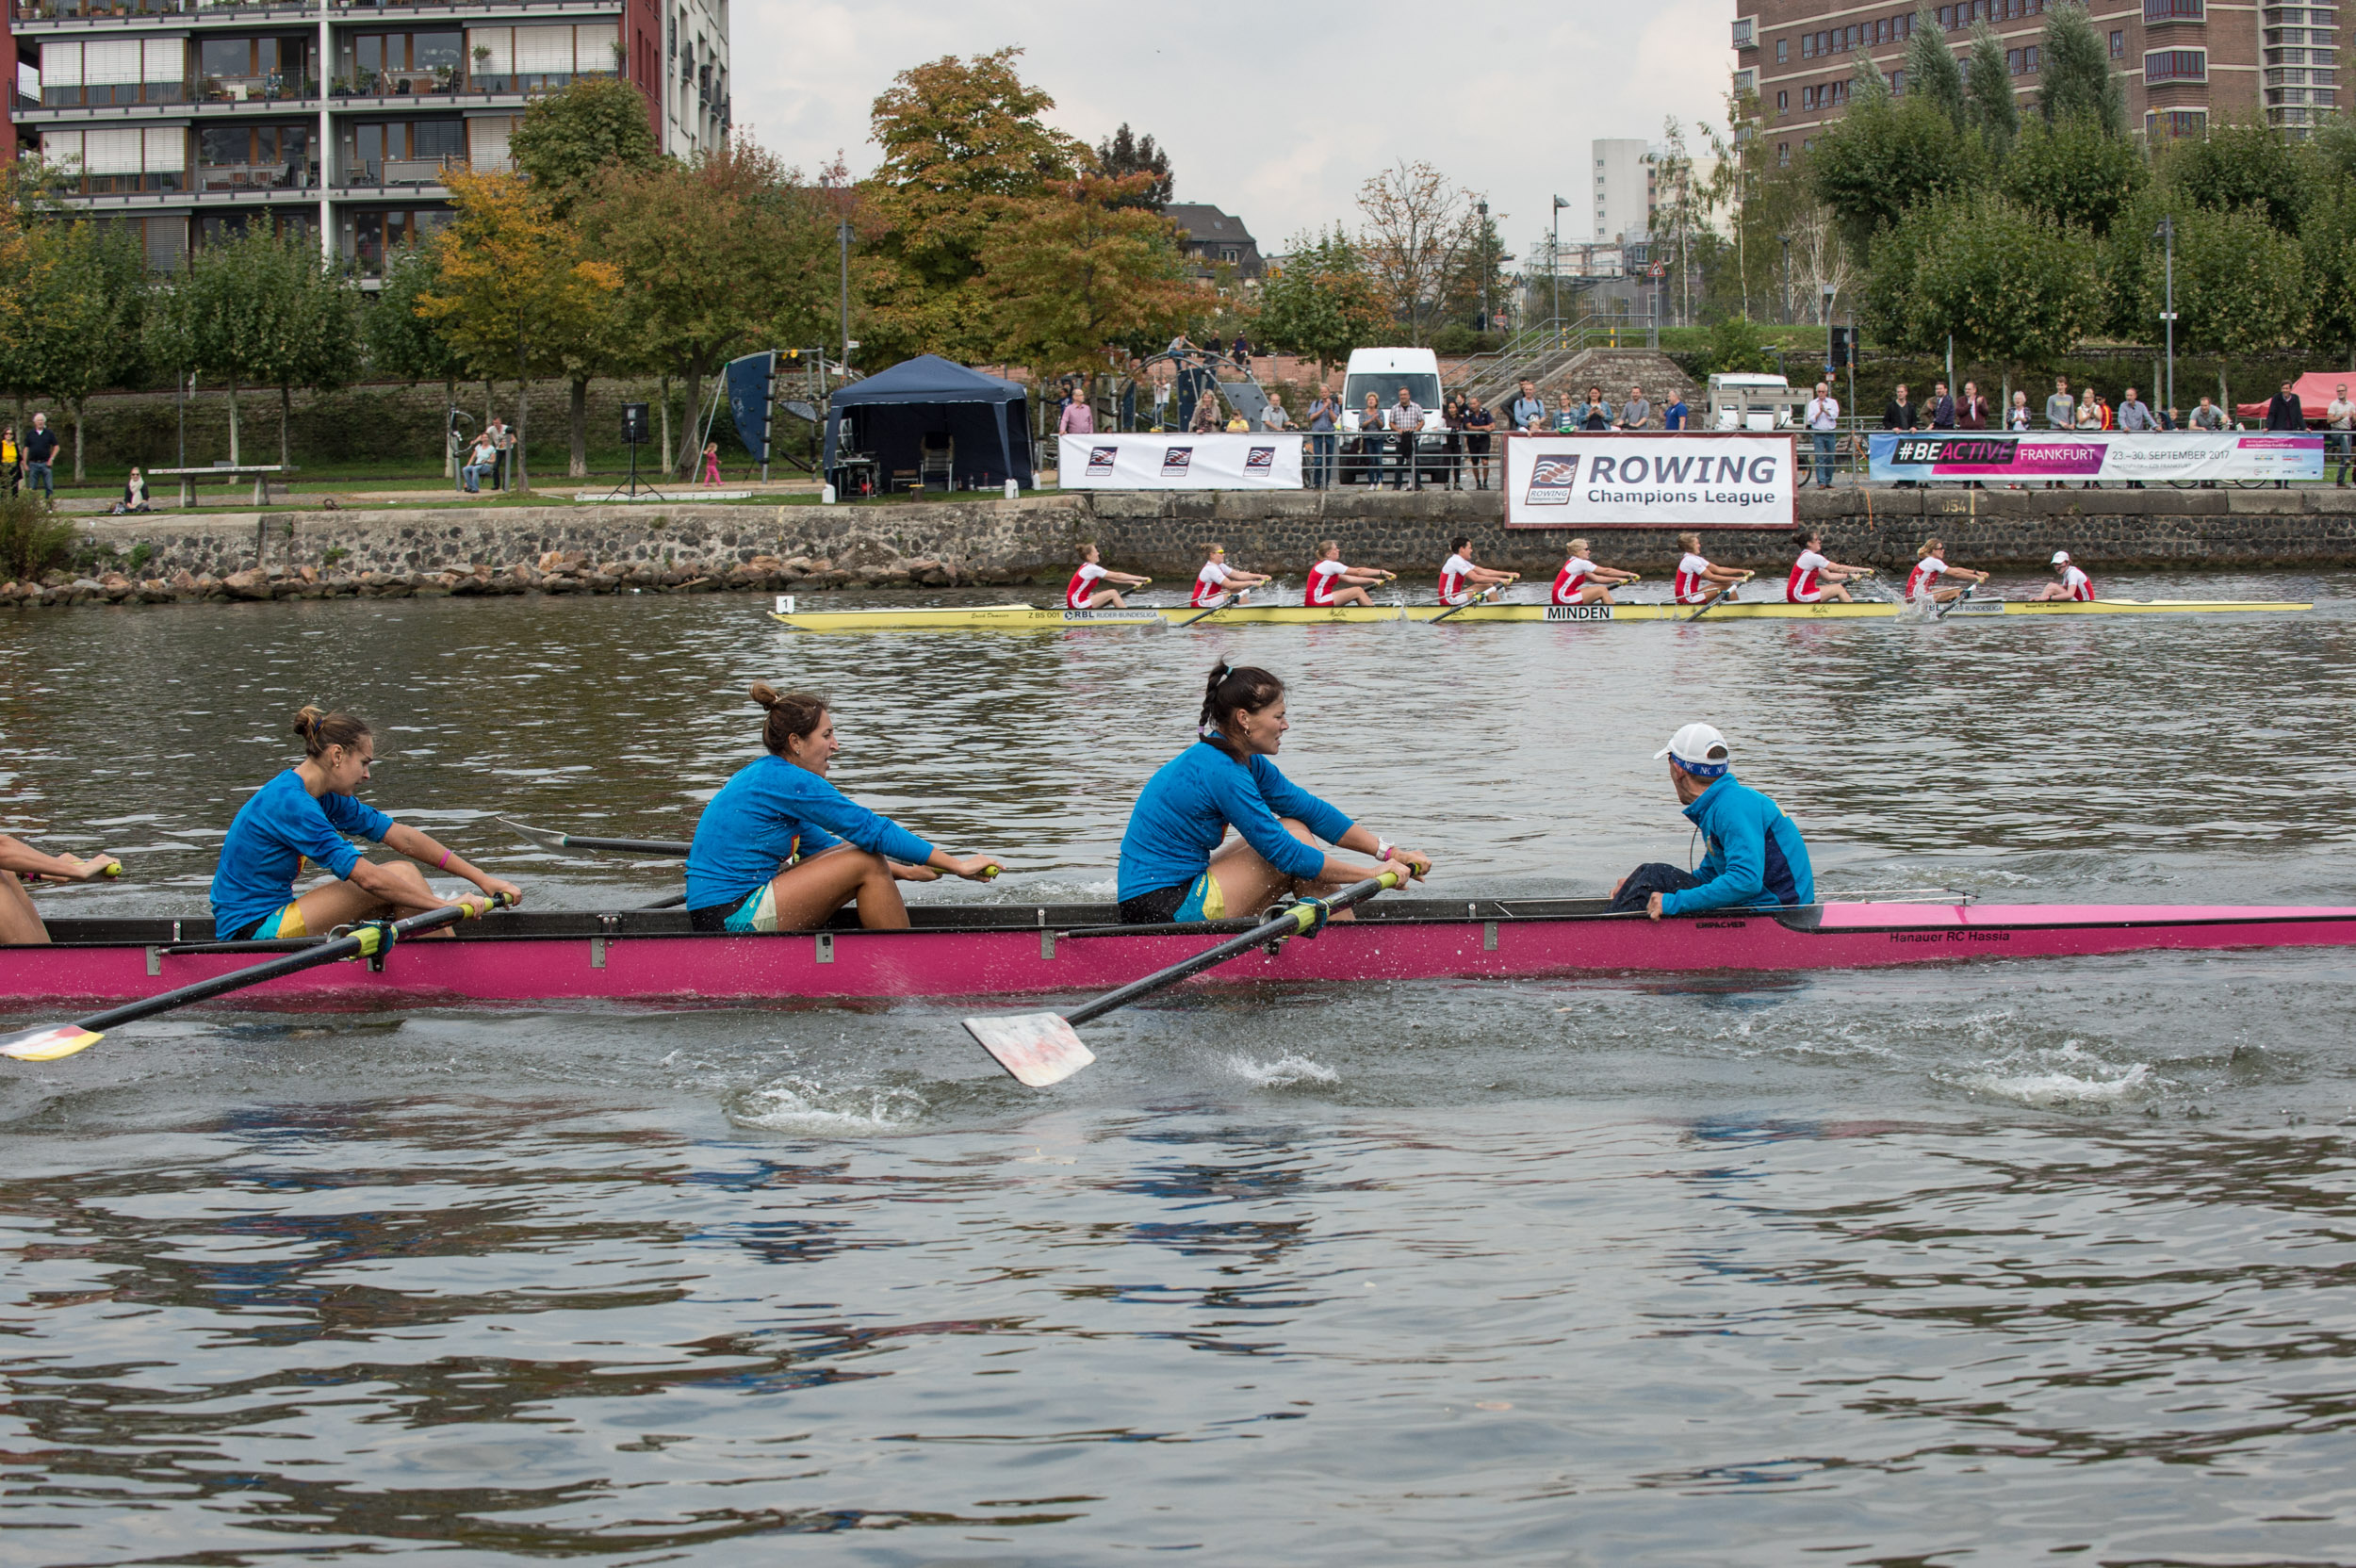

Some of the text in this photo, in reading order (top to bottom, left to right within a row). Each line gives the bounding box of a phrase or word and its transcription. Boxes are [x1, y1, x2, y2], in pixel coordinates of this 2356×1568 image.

[1898, 443, 2013, 461] #BEACTIVE
[2020, 449, 2095, 461] FRANKFURT
[2149, 450, 2206, 460] SEPTEMBER
[2209, 450, 2230, 460] 2017
[1588, 455, 1777, 484] ROWING
[1587, 489, 1775, 507] Champions League
[782, 598, 788, 609] 1
[1547, 607, 1610, 619] MINDEN
[1684, 760, 1694, 772] NK
[1700, 766, 1711, 775] NK
[1695, 921, 1746, 929] EMPACHER
[1890, 931, 2010, 943] Hanauer RC Hassia
